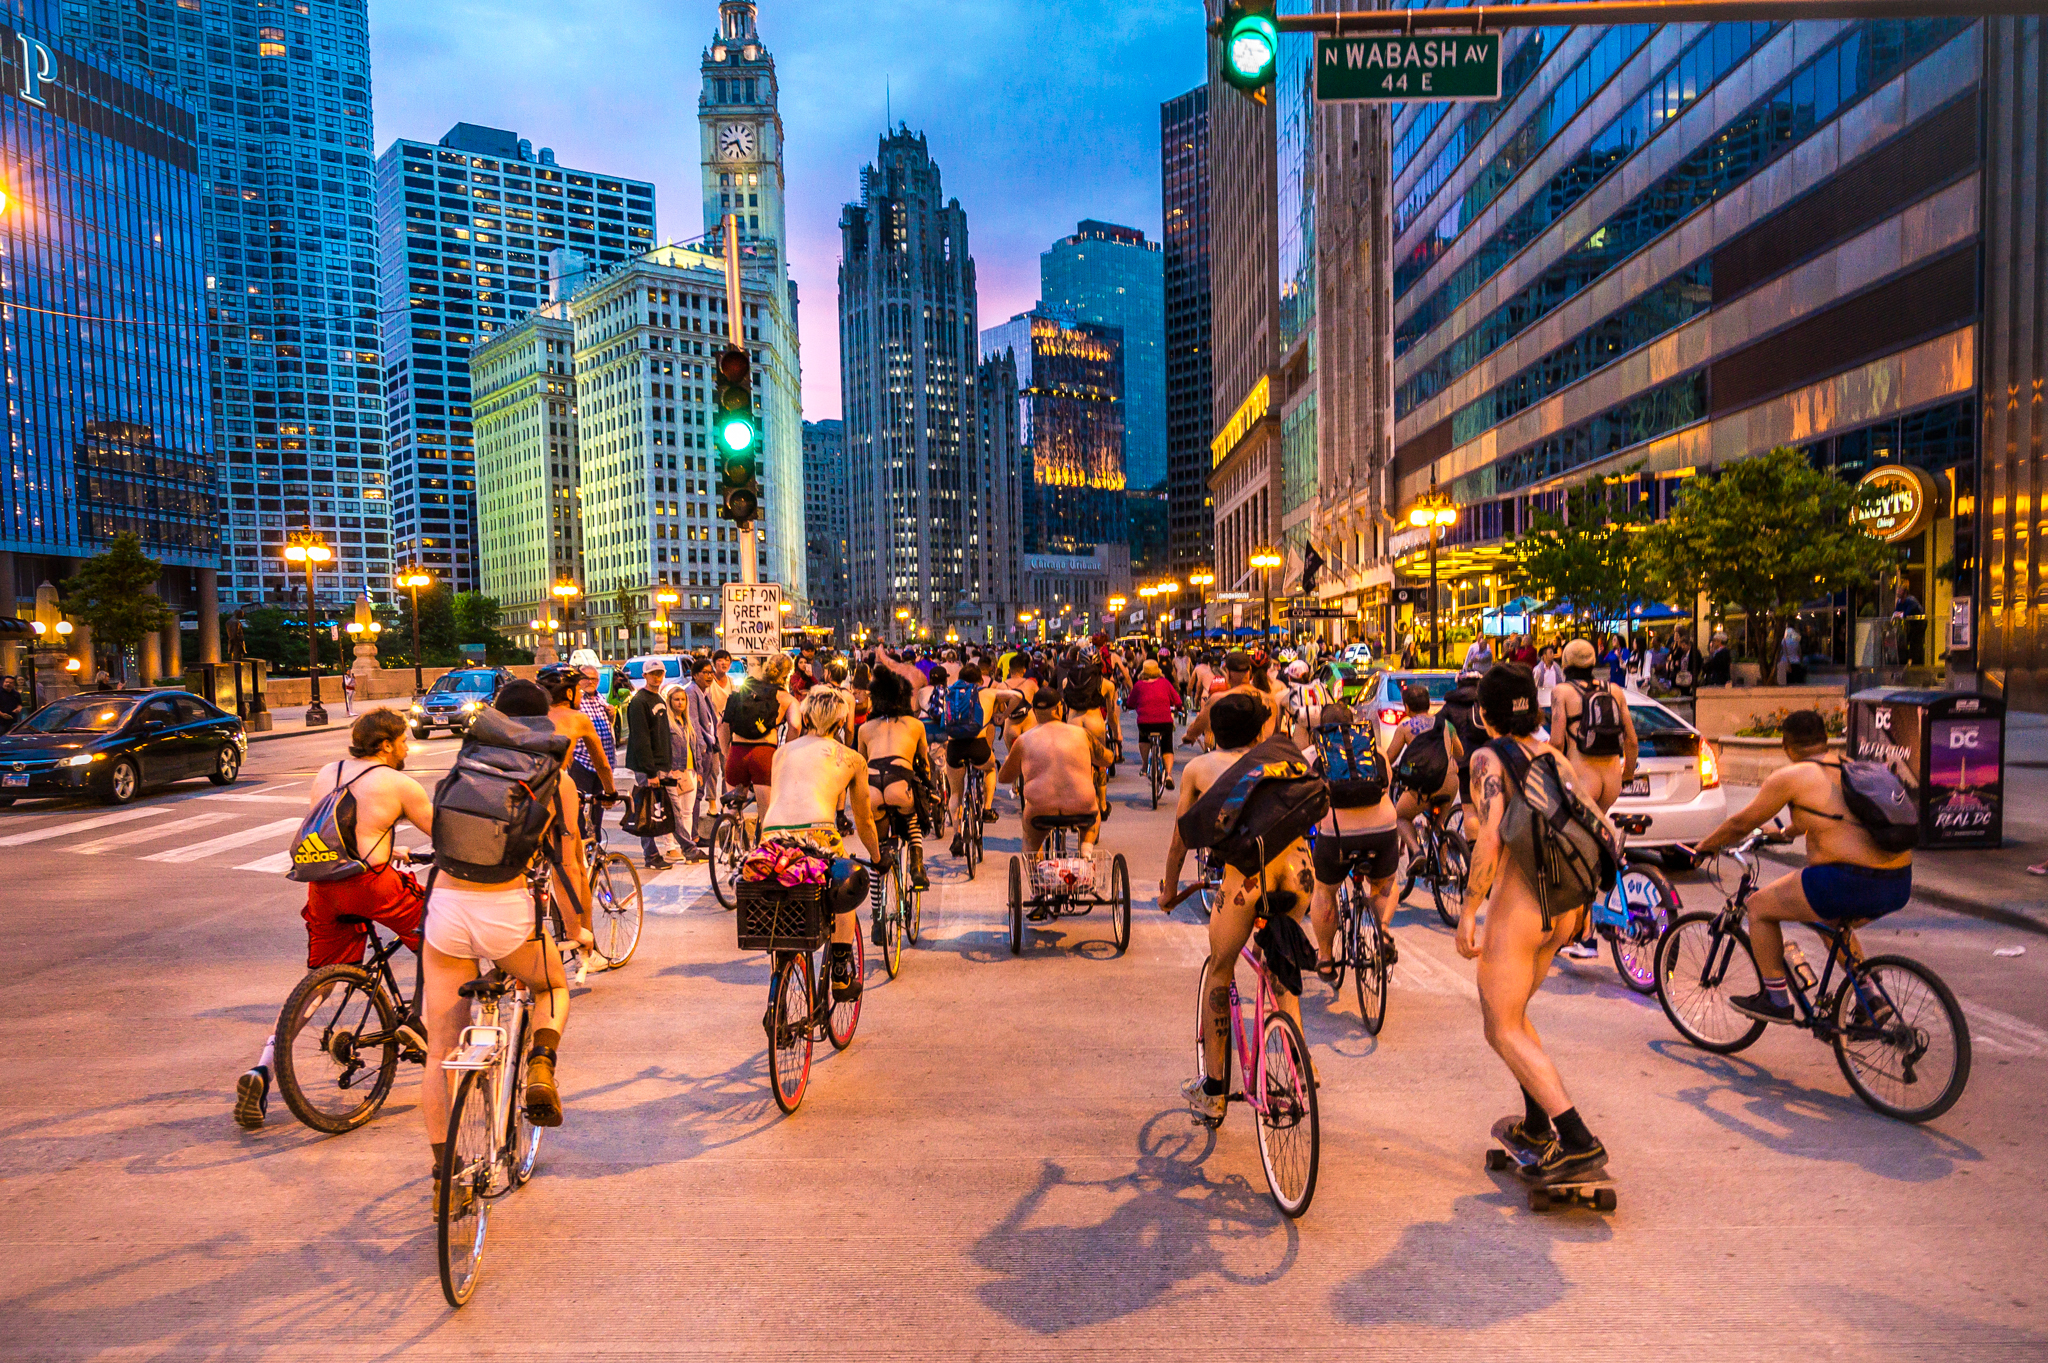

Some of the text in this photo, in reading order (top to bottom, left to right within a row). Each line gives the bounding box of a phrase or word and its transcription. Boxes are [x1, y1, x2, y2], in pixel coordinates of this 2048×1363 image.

[1325, 40, 1489, 69] N WABASH AV
[16, 32, 58, 109] P
[1381, 73, 1433, 92] 44 E
[1031, 556, 1101, 570] Chicago Tribune
[728, 588, 777, 602] LEFT ON
[737, 636, 767, 650] ONLY
[1875, 711, 1891, 730] DC
[1950, 731, 1979, 749] DC
[1935, 810, 1992, 828] REAL DC
[294, 850, 339, 864] adidas
